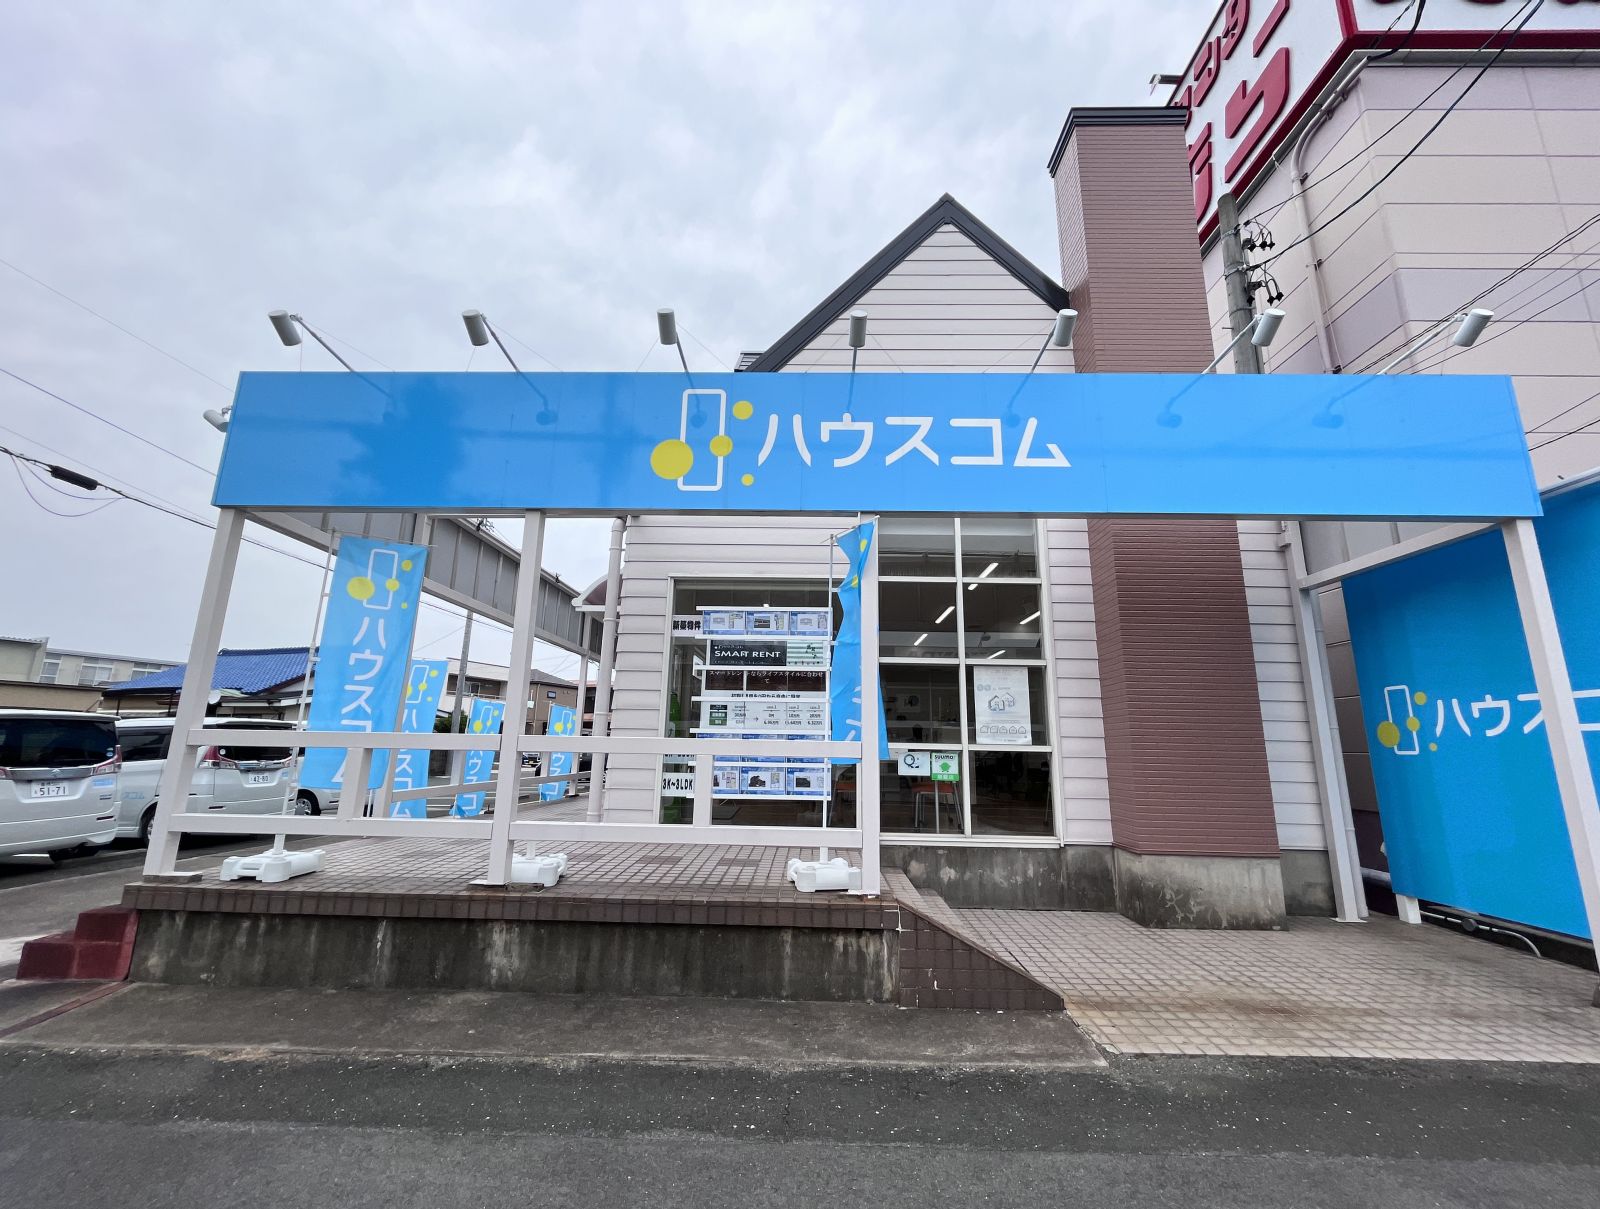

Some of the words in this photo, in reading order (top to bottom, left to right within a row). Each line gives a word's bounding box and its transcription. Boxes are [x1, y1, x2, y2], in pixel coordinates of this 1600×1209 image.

[757, 412, 1072, 468] ハウスコム
[39, 786, 66, 796] 51-71
